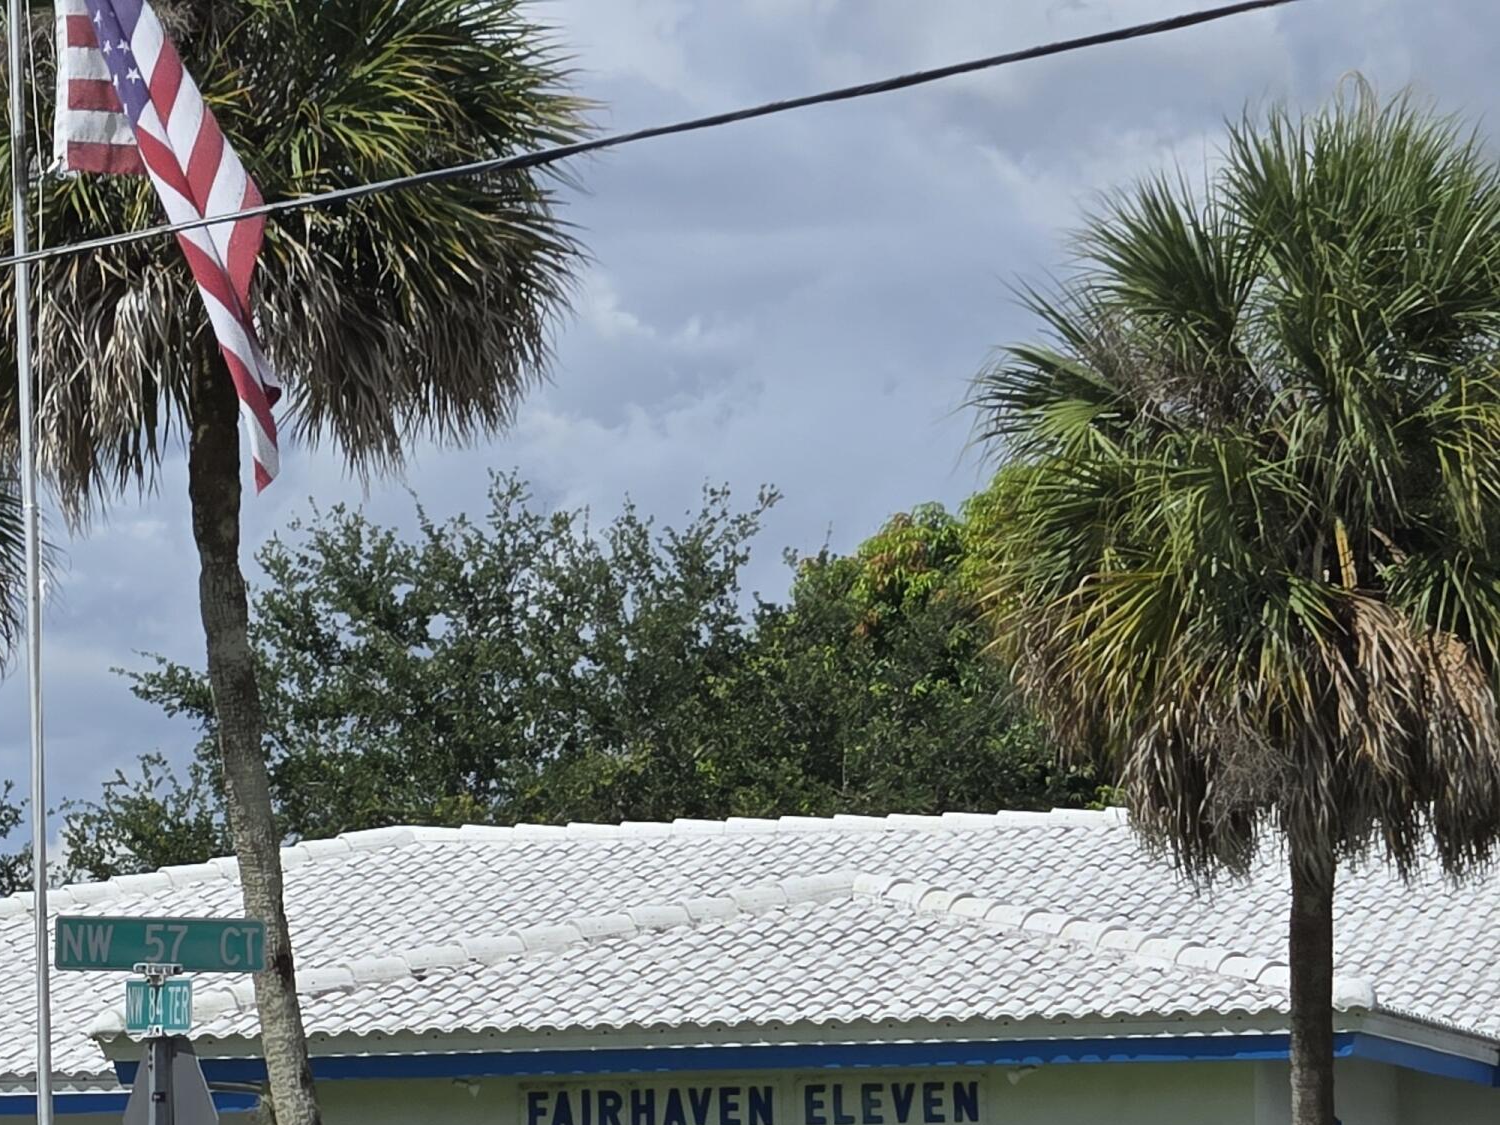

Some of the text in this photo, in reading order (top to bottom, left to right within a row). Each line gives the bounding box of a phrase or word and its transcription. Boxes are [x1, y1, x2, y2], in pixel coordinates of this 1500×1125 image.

[62, 924, 259, 966] NW 57 CT
[127, 985, 189, 1026] NW 84 TER
